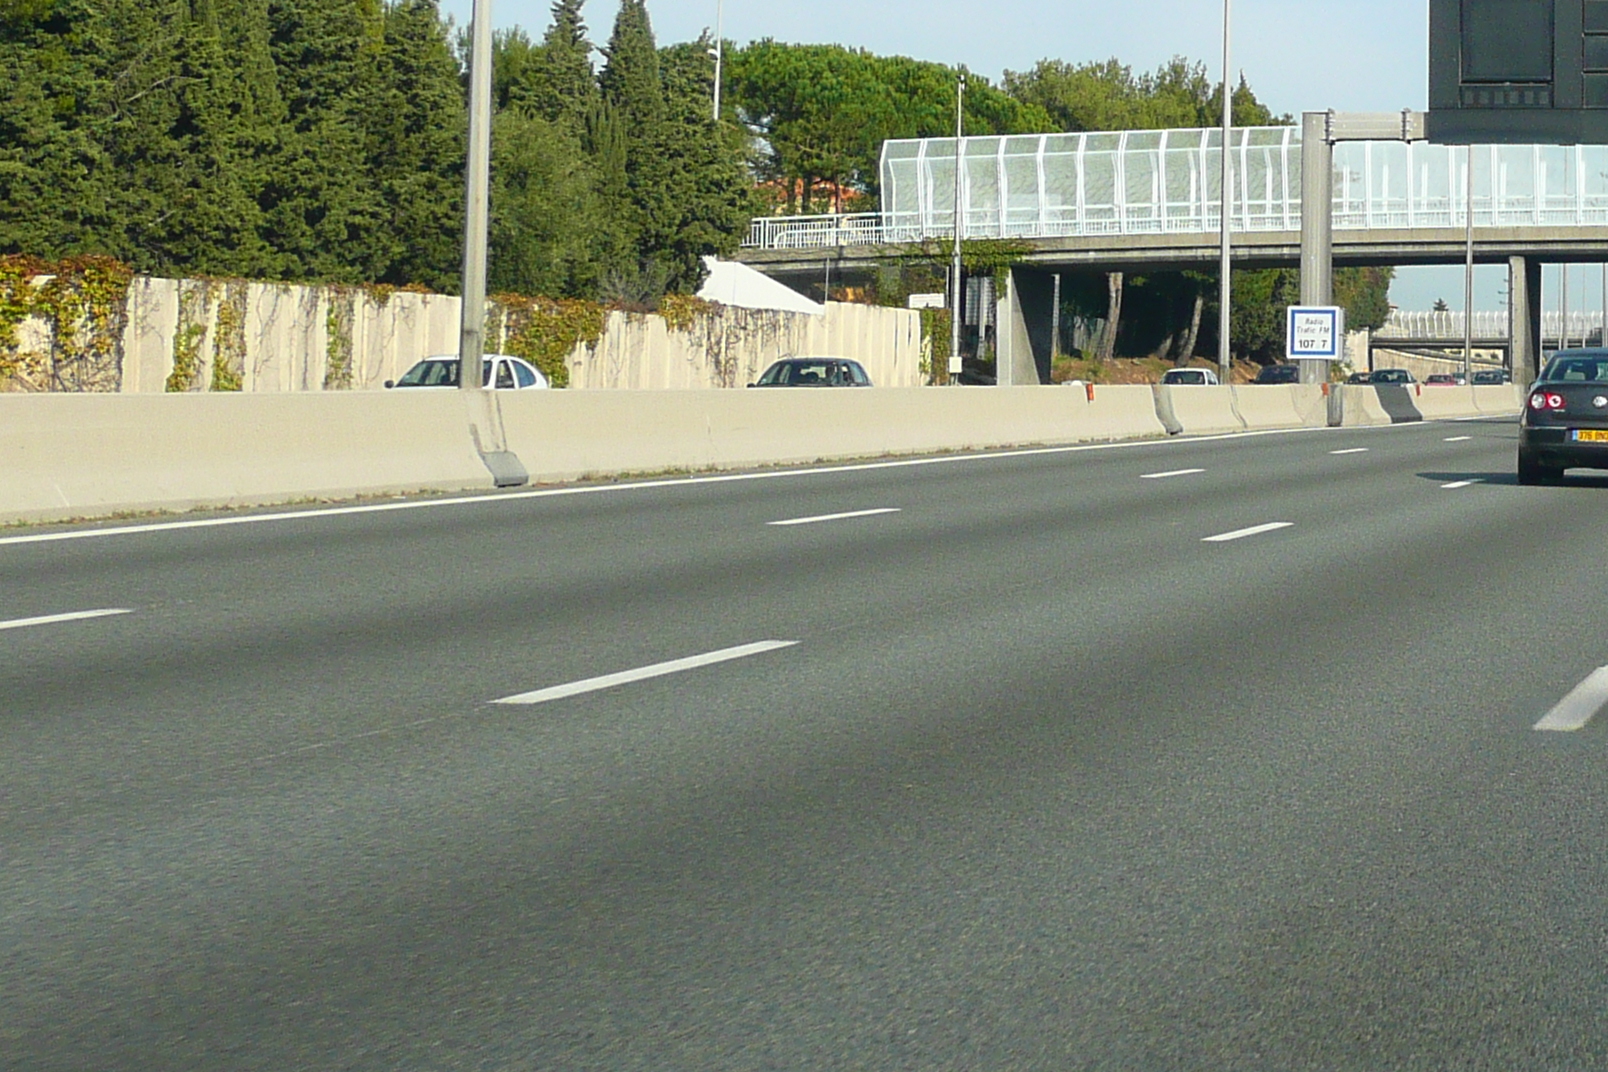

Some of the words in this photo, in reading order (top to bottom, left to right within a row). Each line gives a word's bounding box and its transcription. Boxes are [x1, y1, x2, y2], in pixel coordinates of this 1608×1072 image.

[1305, 317, 1324, 325] Radio
[1297, 325, 1316, 334] Trafic
[1319, 326, 1329, 334] FM
